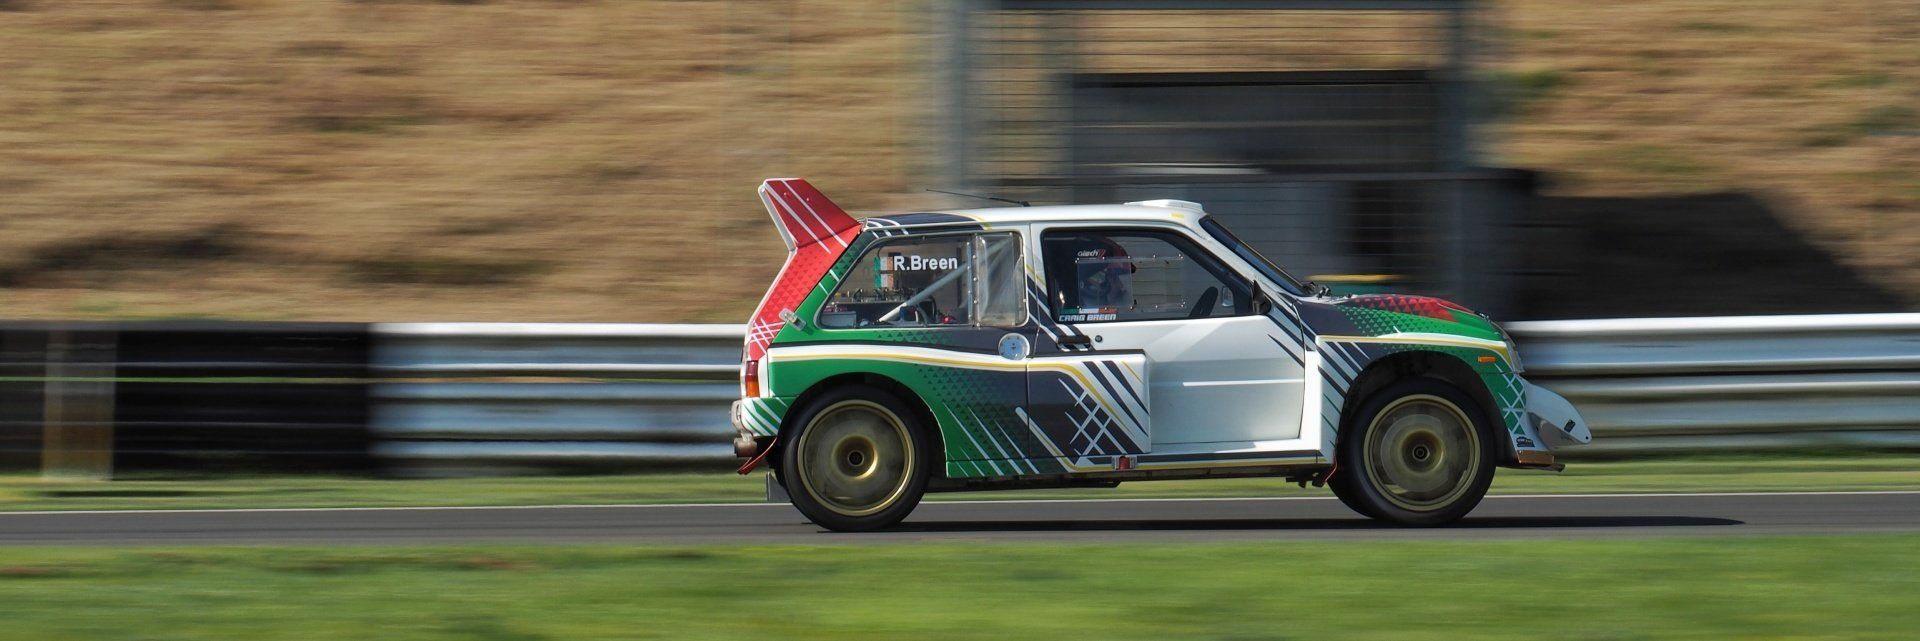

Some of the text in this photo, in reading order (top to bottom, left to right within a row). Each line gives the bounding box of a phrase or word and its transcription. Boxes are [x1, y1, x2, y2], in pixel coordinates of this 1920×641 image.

[893, 255, 958, 271] R.Breen
[1058, 313, 1117, 322] CRAIG BREEN
